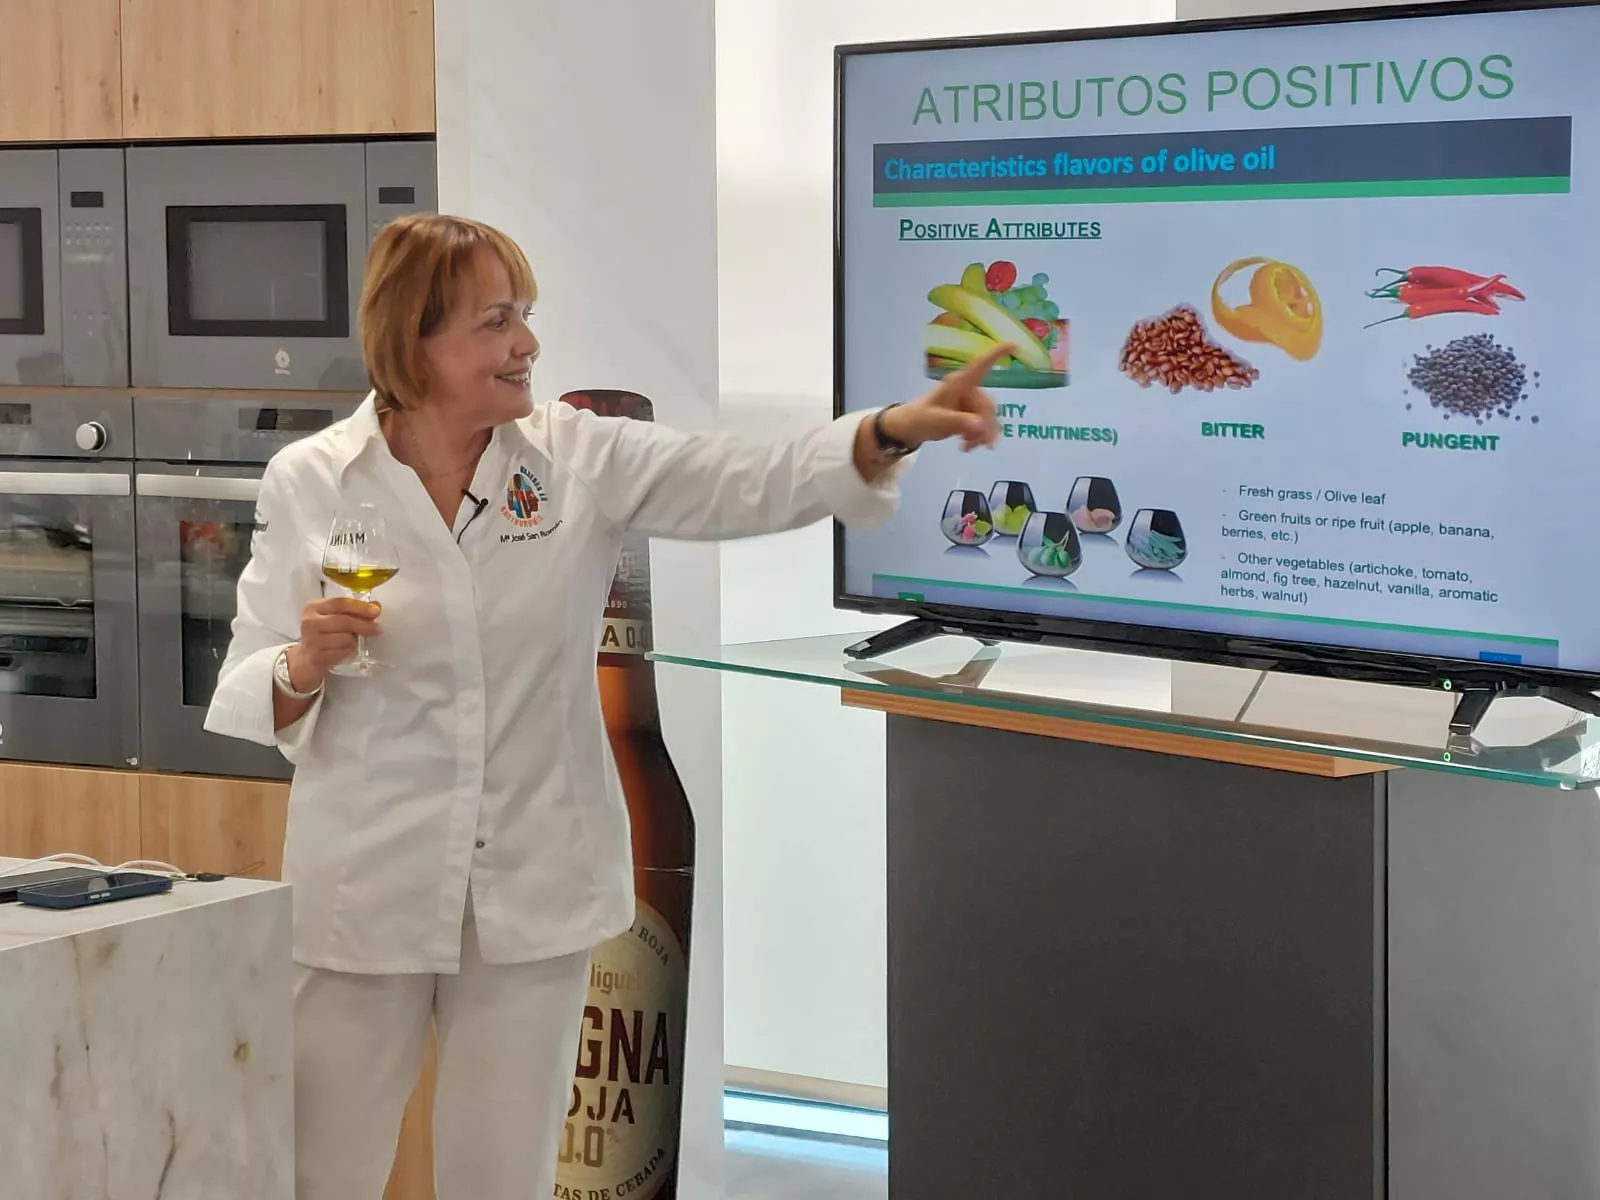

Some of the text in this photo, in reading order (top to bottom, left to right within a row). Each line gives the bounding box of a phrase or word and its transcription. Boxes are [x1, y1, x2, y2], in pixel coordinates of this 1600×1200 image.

[912, 54, 1514, 125] ATRIBUTOS POSITIVOS
[885, 145, 1275, 180] Characteristics flavors of olive oil
[900, 218, 1102, 238] POSITIVE ATTRIBUTES
[1018, 424, 1118, 446] FRUITINESS)
[1201, 422, 1265, 439] BITTER
[1402, 432, 1500, 451] PUNGENT
[1239, 485, 1274, 498] Fresh
[1277, 489, 1313, 501] grass
[1324, 489, 1358, 503] Olive
[1361, 492, 1386, 504] leaf
[1221, 526, 1299, 544] berries, etc.)
[1239, 509, 1494, 540] Green fruits or ripe fruit (apple, banana,
[1237, 552, 1473, 584] Other vegetables (artichoke, tomato,
[1220, 568, 1499, 602] almond, fig tree, hazelnut, vanilla, aromatic
[1220, 584, 1308, 606] herbs, walnut)
[636, 924, 669, 967] ROJA
[575, 1005, 671, 1086] GNA
[587, 1188, 610, 1200] DE
[616, 1148, 665, 1197] CEBADA
